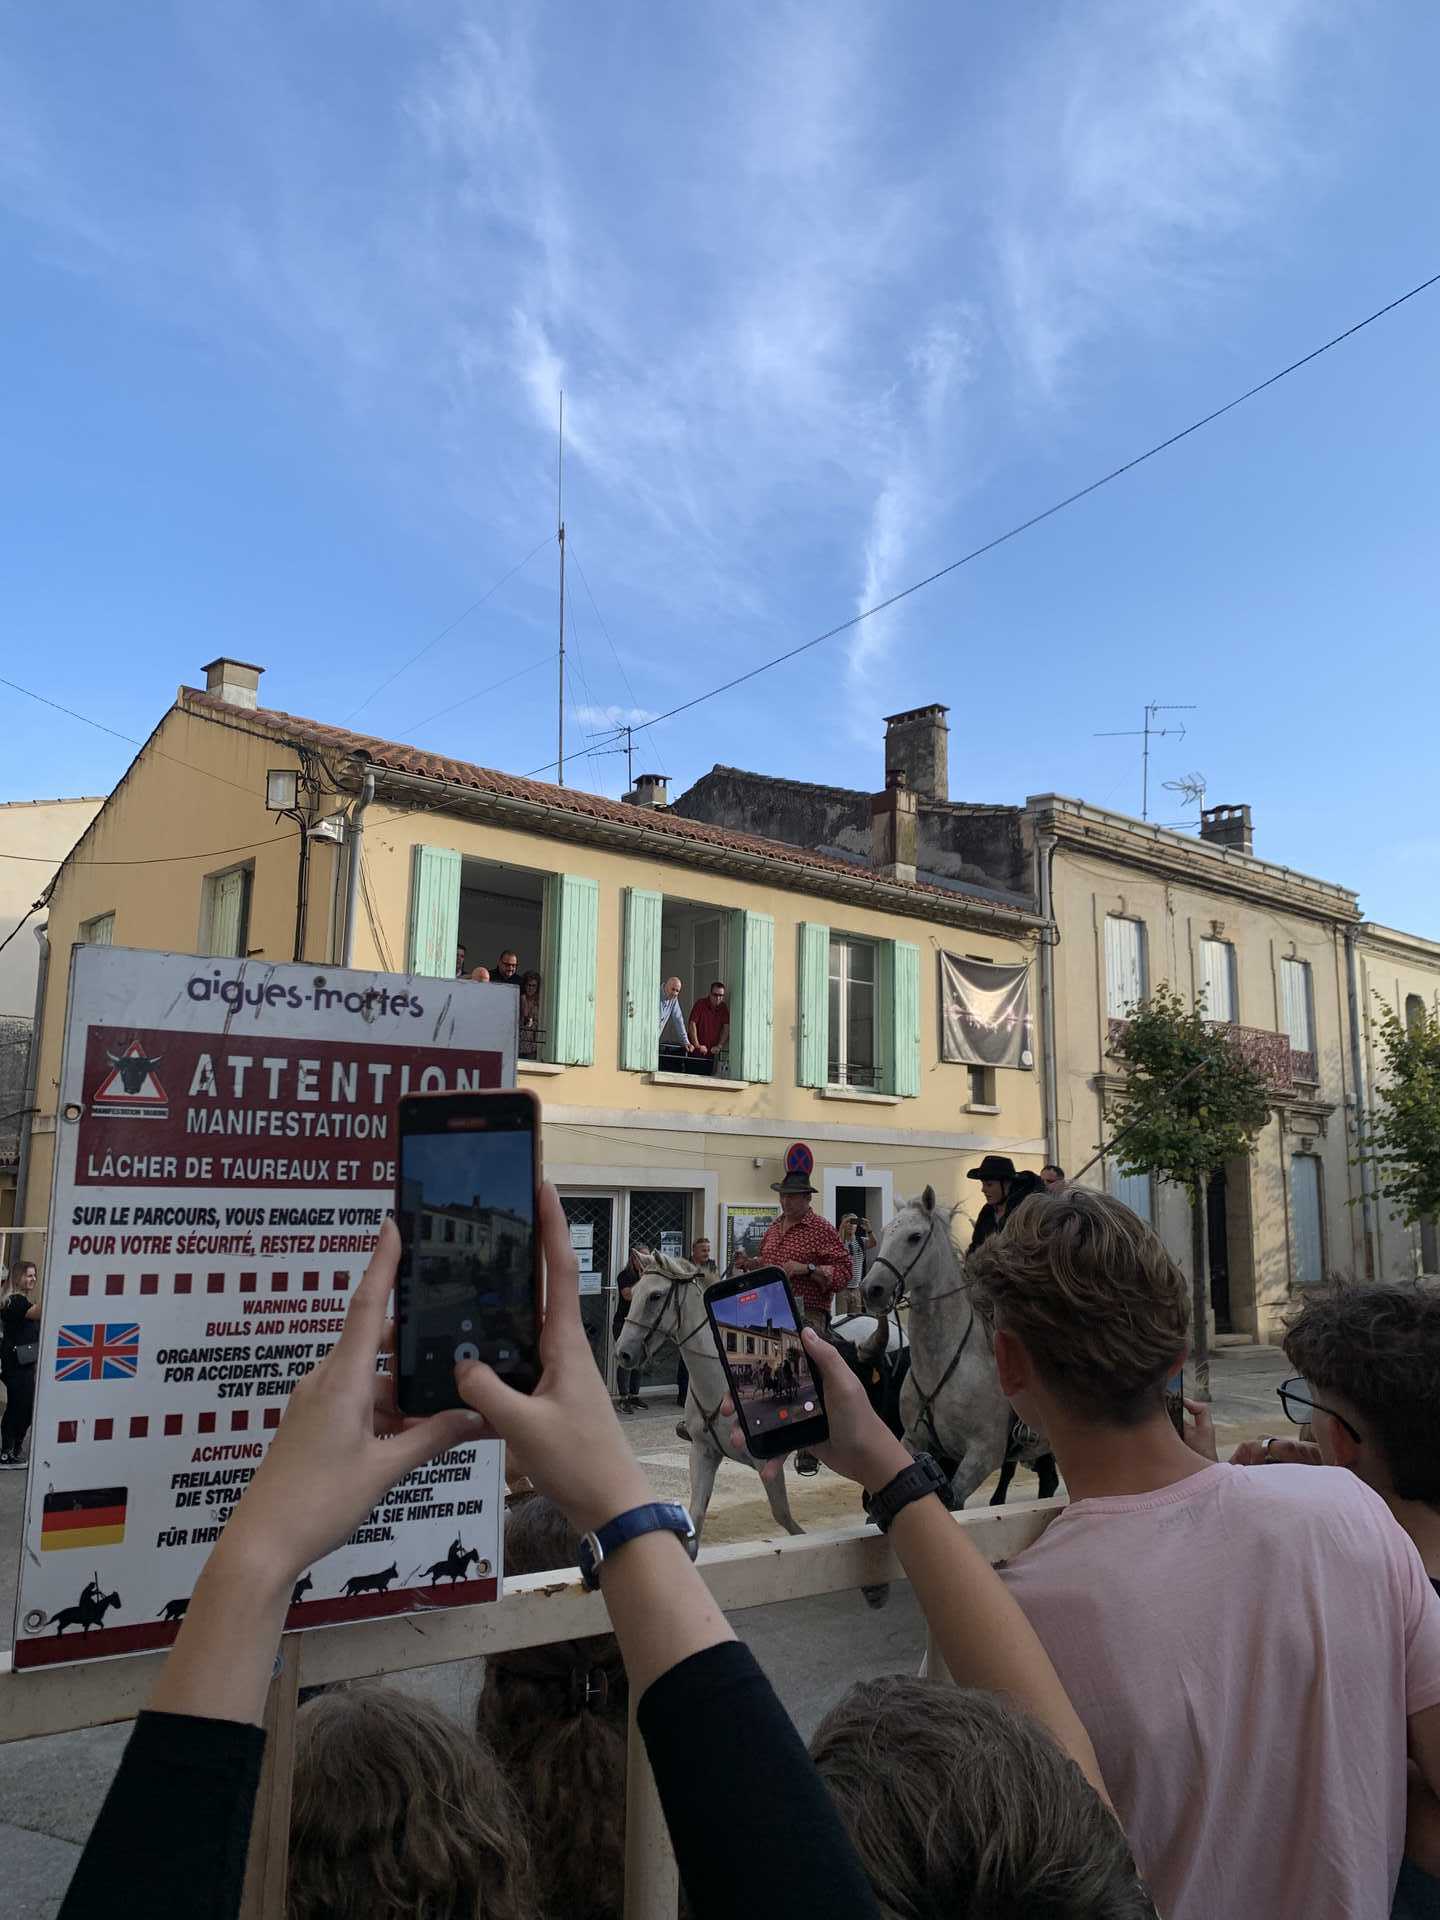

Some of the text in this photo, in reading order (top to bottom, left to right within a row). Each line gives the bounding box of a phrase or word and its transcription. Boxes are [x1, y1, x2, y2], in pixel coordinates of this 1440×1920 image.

[187, 970, 424, 1018] aigues-mortes
[188, 1053, 480, 1104] ATTENTION
[186, 1108, 388, 1139] MANIFESTATION
[88, 1147, 177, 1178] LÂCHER
[185, 1157, 213, 1179] DE
[221, 1158, 330, 1181] TAUREAUX
[336, 1160, 360, 1181] ET
[72, 1206, 107, 1226] SUR
[110, 1207, 130, 1226] LE
[132, 1207, 220, 1229] PARCOURS,
[225, 1208, 265, 1226] VOUS
[268, 1208, 335, 1226] ENGAGEZ
[338, 1208, 382, 1226] VOTRE
[68, 1229, 380, 1256] POUR VOTRE SÉCURITÉ, RESTEZ DERRIÈR
[243, 1298, 345, 1314] WARNING BULL
[206, 1320, 251, 1337] BULLS
[255, 1319, 285, 1336] AND
[156, 1346, 251, 1365] ORGANISERS
[255, 1343, 313, 1361] CANNOT
[163, 1366, 195, 1383] FOR
[197, 1362, 283, 1382] ACCIDENTS.
[217, 1380, 300, 1398] STAY BEHI
[191, 1443, 263, 1463] ACHTUNG
[170, 1449, 477, 1489] FREILAUFE DURCH
[175, 1466, 471, 1508] DIE STRA PFLICHTEN
[157, 1526, 188, 1548] FÜR
[191, 1526, 225, 1545] IHR
[382, 1507, 404, 1524] SIE
[406, 1502, 454, 1521] HINTER
[457, 1500, 483, 1516] DEN
[347, 1526, 395, 1546] IEREN.
